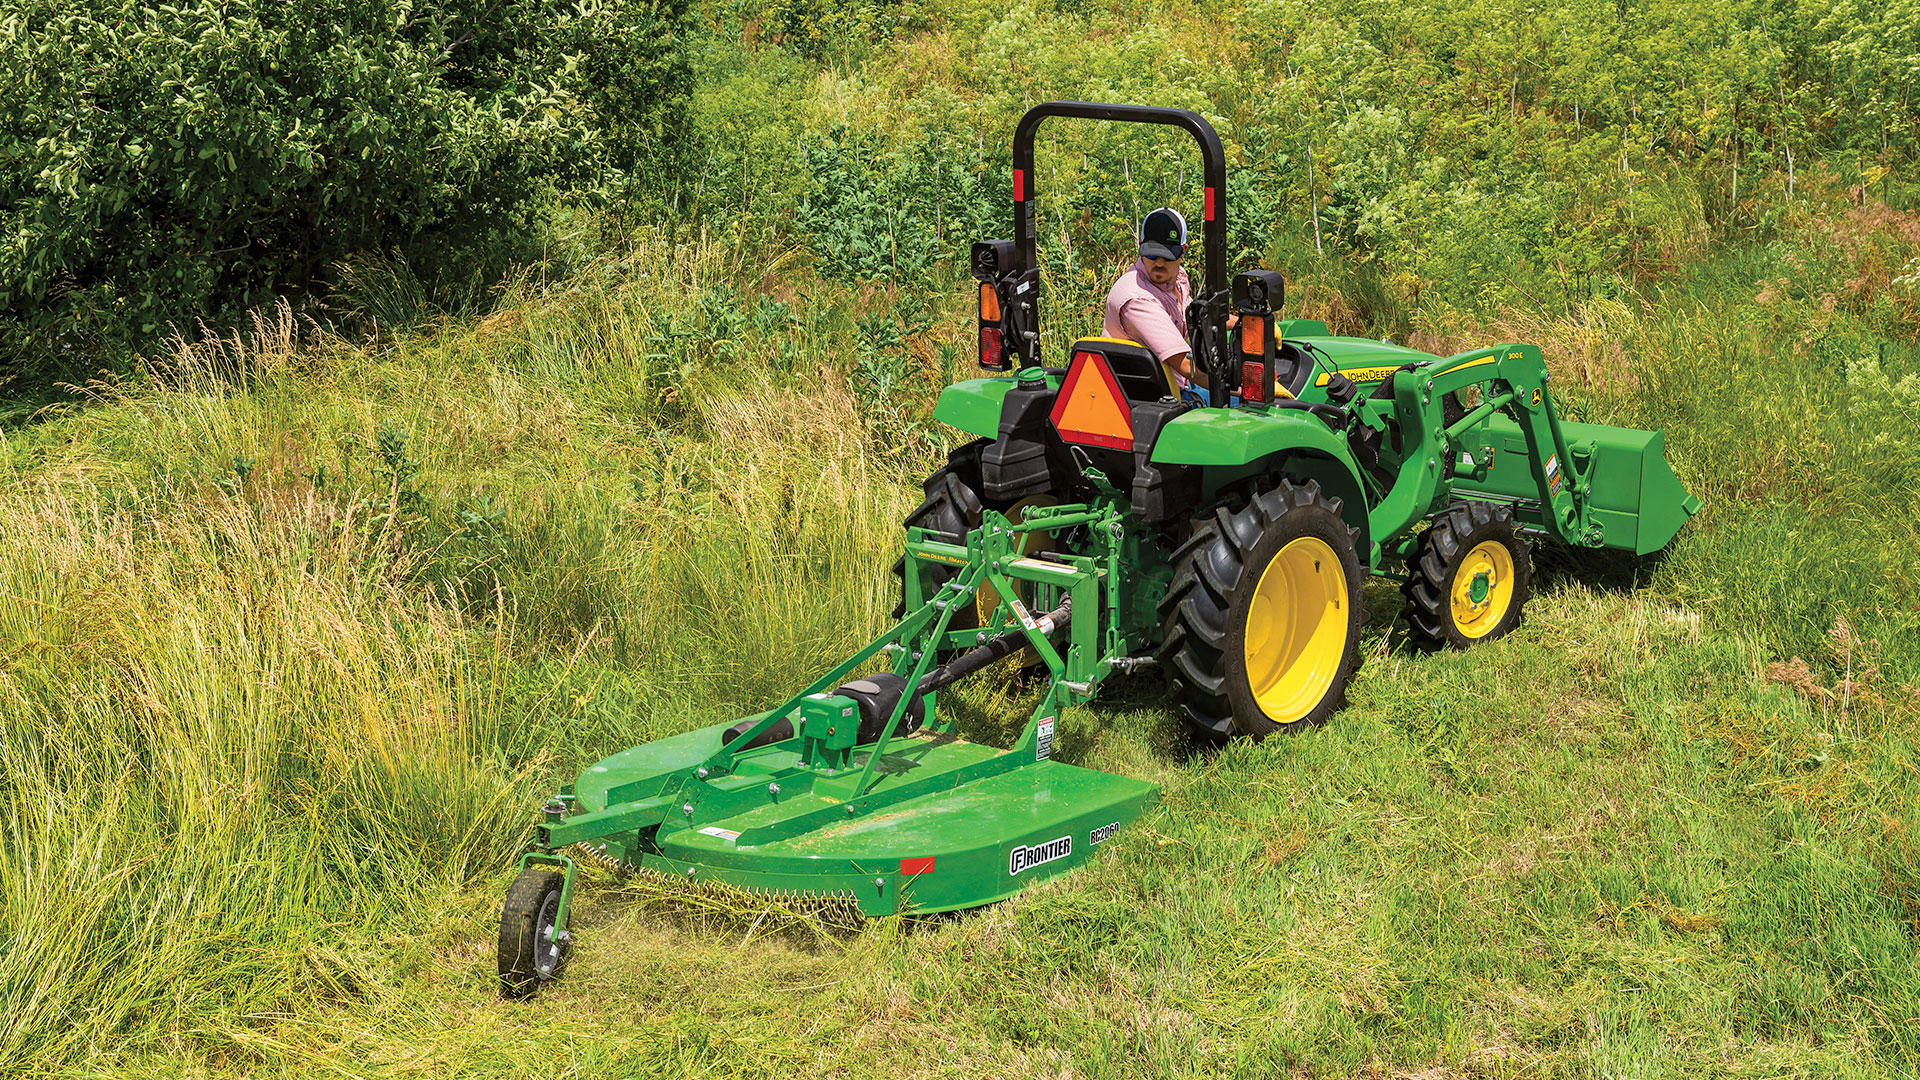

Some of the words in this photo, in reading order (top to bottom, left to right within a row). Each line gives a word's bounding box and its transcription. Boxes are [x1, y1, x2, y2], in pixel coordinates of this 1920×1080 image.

[1348, 371, 1369, 381] JOHN
[930, 553, 947, 561] DEERE
[1090, 822, 1120, 845] RC2060
[1010, 837, 1071, 875] FRONTIER
